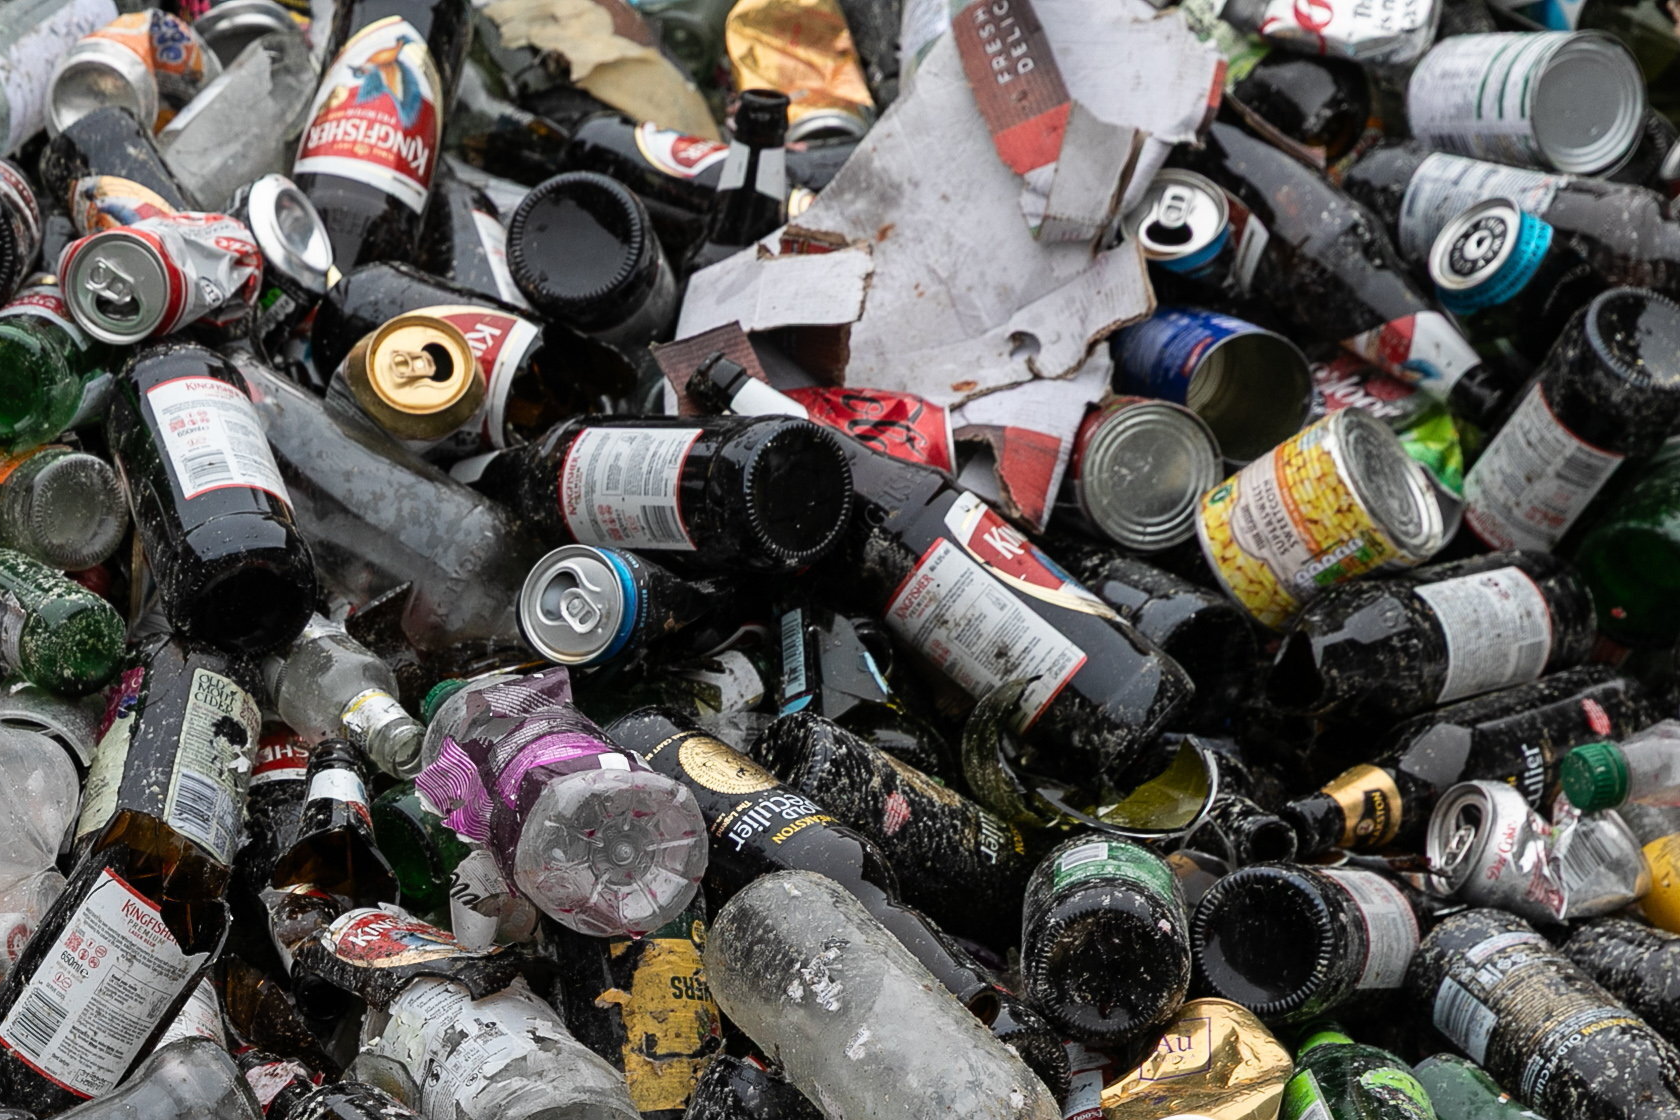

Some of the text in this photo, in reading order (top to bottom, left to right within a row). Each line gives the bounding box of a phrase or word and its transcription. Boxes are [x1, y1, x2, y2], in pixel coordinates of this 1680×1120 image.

[974, 7, 1012, 85] FRESH
[308, 122, 430, 177] KINGFISHER
[199, 674, 226, 691] OLD
[1497, 819, 1518, 856] Coke
[127, 918, 165, 946] PREMIUM
